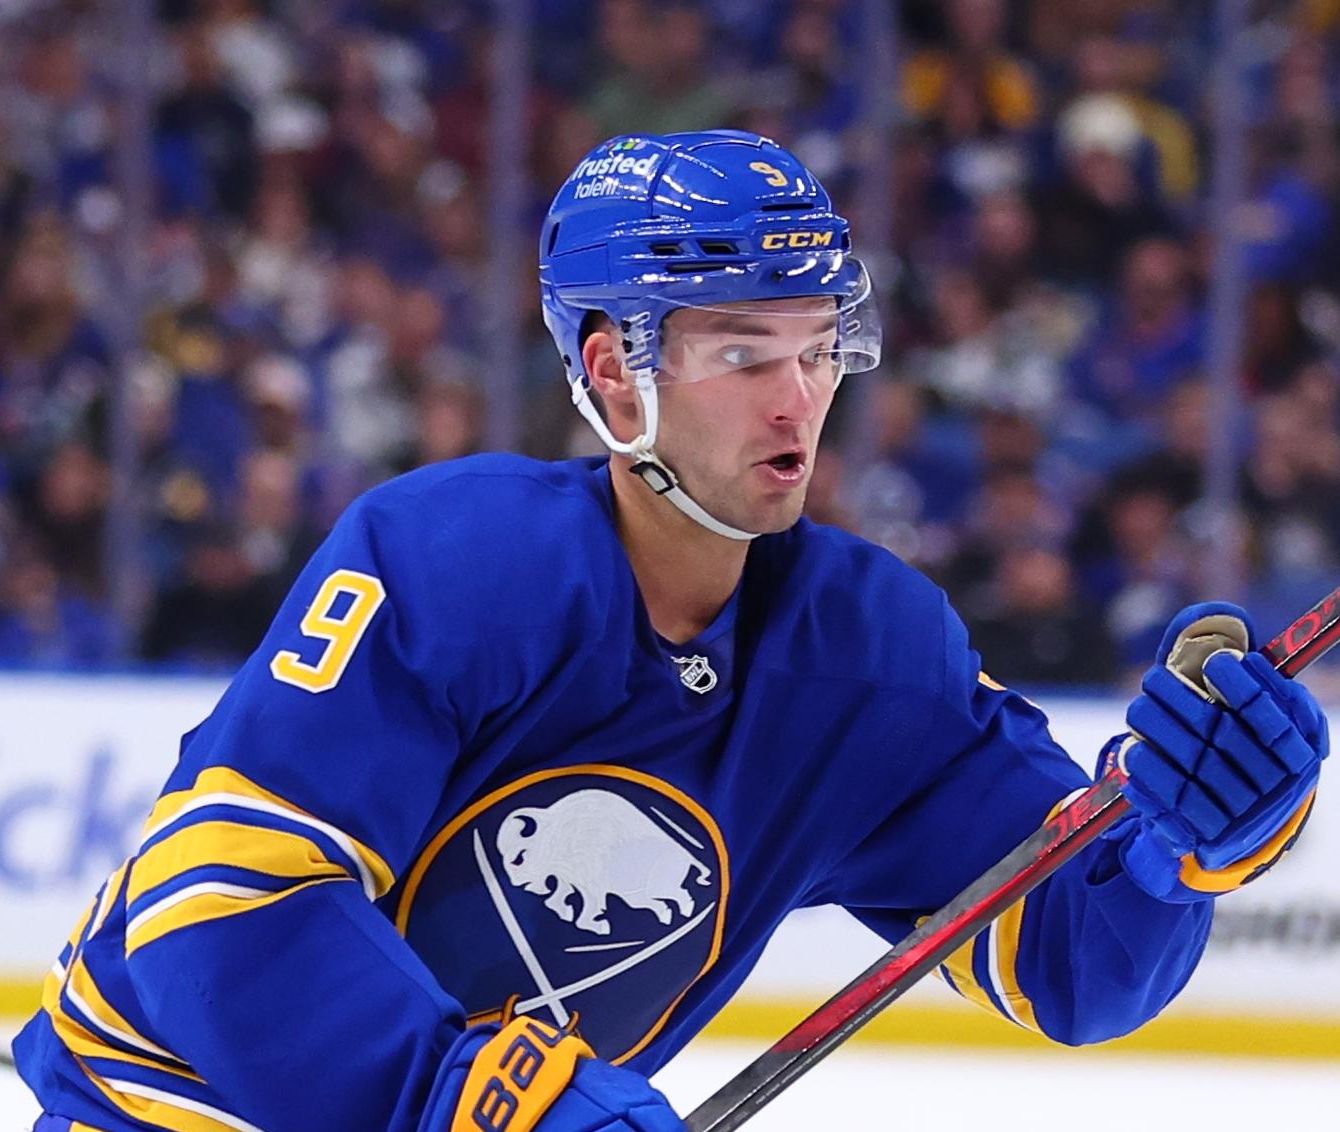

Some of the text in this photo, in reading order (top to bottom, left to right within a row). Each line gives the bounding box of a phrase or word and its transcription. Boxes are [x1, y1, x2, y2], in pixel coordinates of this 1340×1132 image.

[749, 162, 789, 187] 9
[762, 231, 834, 250] CCM
[269, 568, 387, 694] 9
